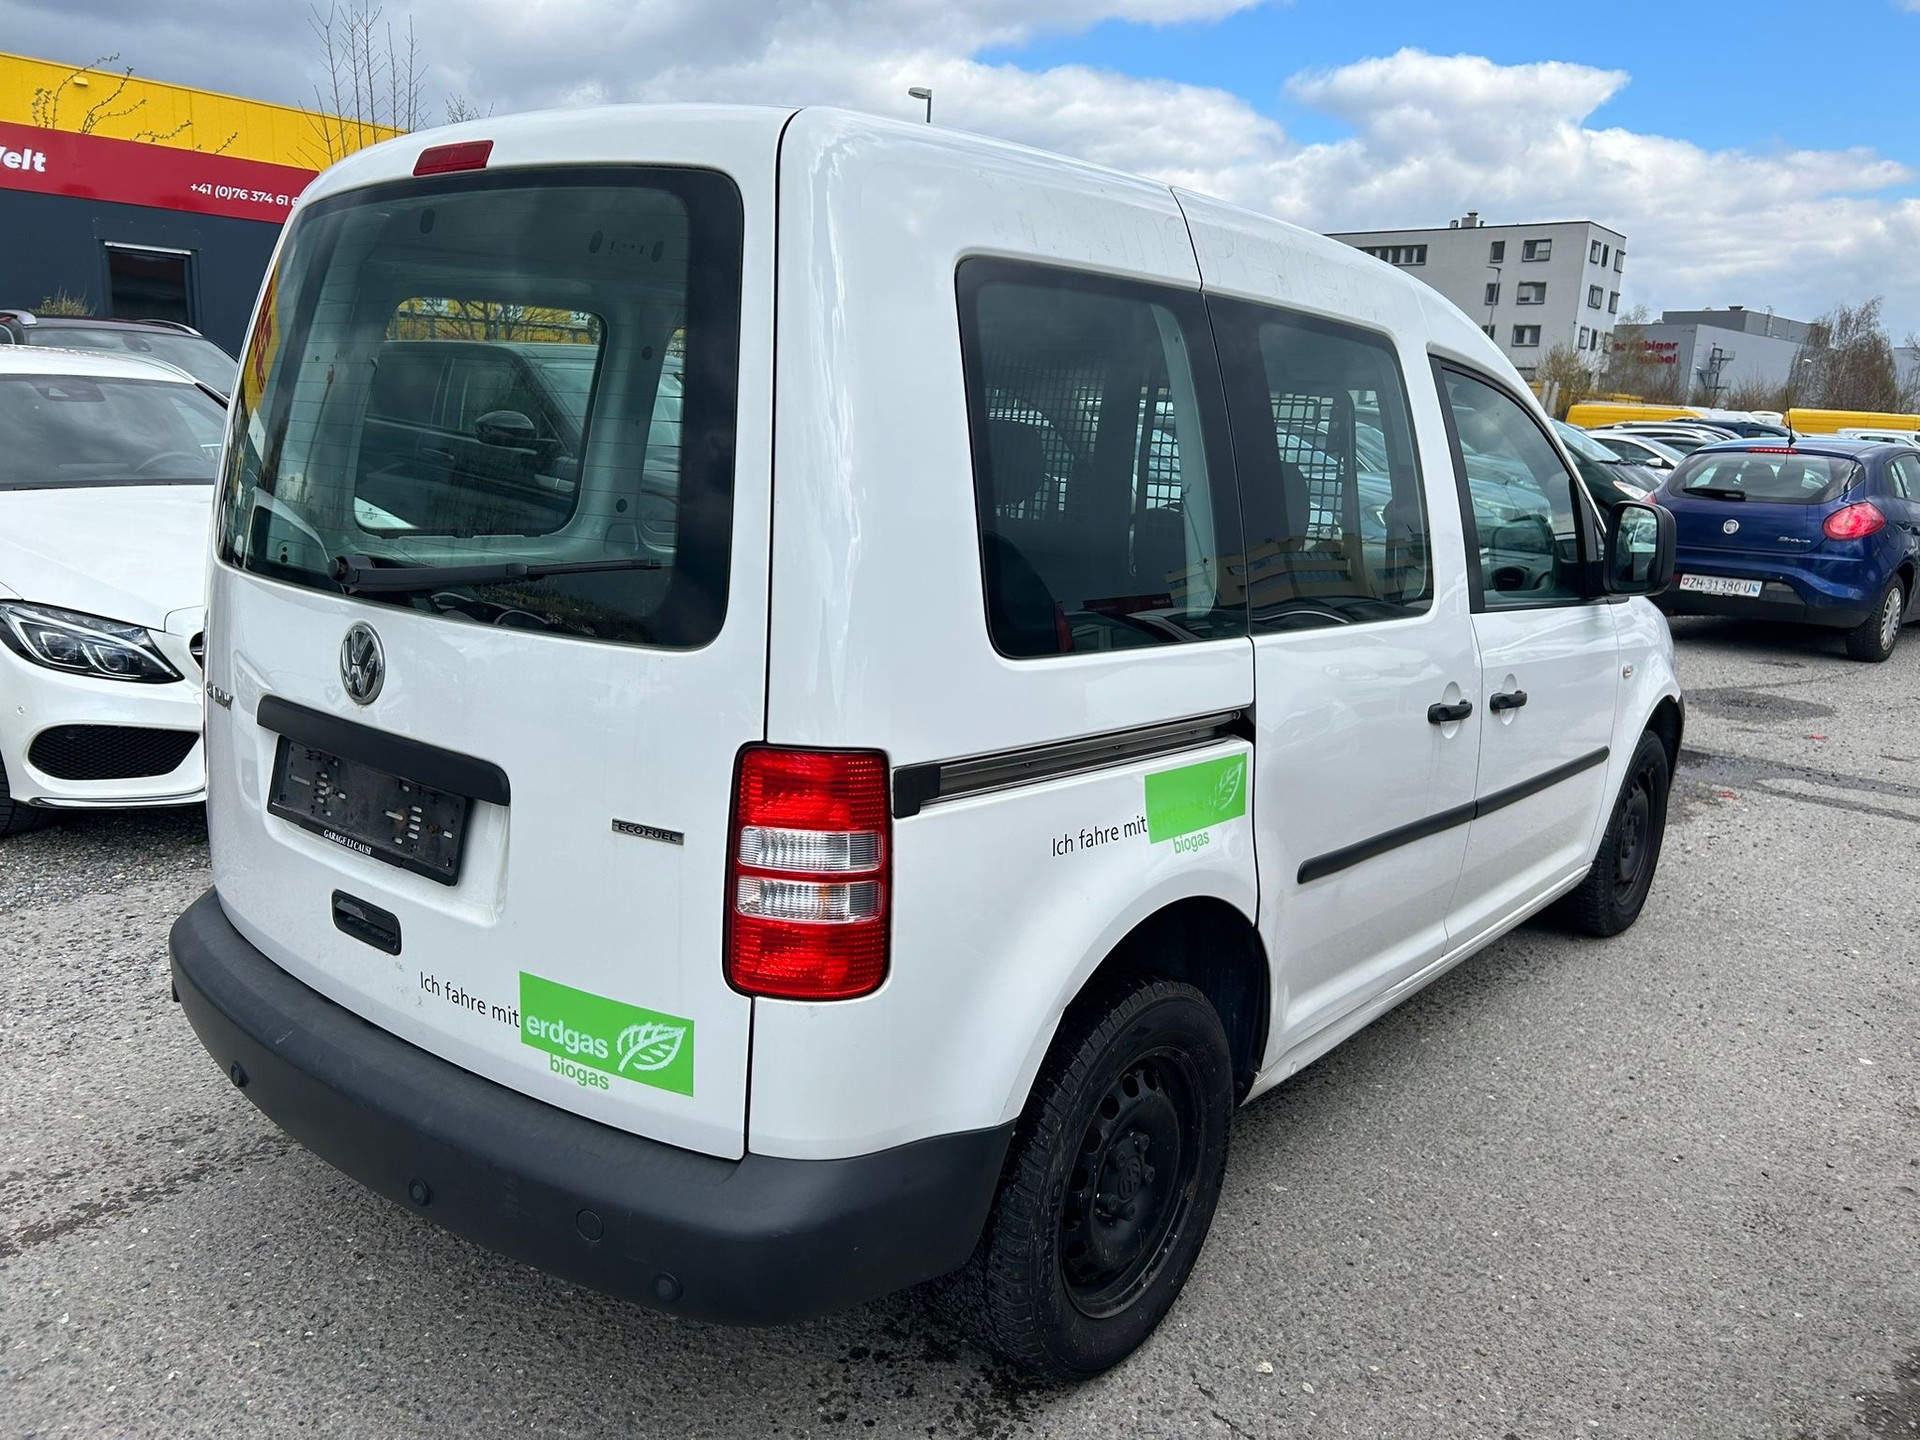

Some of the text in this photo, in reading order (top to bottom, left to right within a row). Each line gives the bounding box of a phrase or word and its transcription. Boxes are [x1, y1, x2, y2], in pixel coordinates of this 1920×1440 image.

[190, 183, 212, 195] +41
[215, 185, 248, 200] (0)76
[250, 190, 274, 204] 374
[275, 194, 289, 206] 61
[1613, 340, 1679, 352] scbiger
[323, 829, 347, 845] GARAGE
[618, 823, 677, 842] ECOFUEL
[1052, 815, 1148, 857] Ich fahre mit
[1173, 830, 1210, 854] biogas
[420, 971, 520, 1028] Ich fahre mit
[525, 1015, 609, 1059] erdgas
[549, 1053, 610, 1090] biogas
